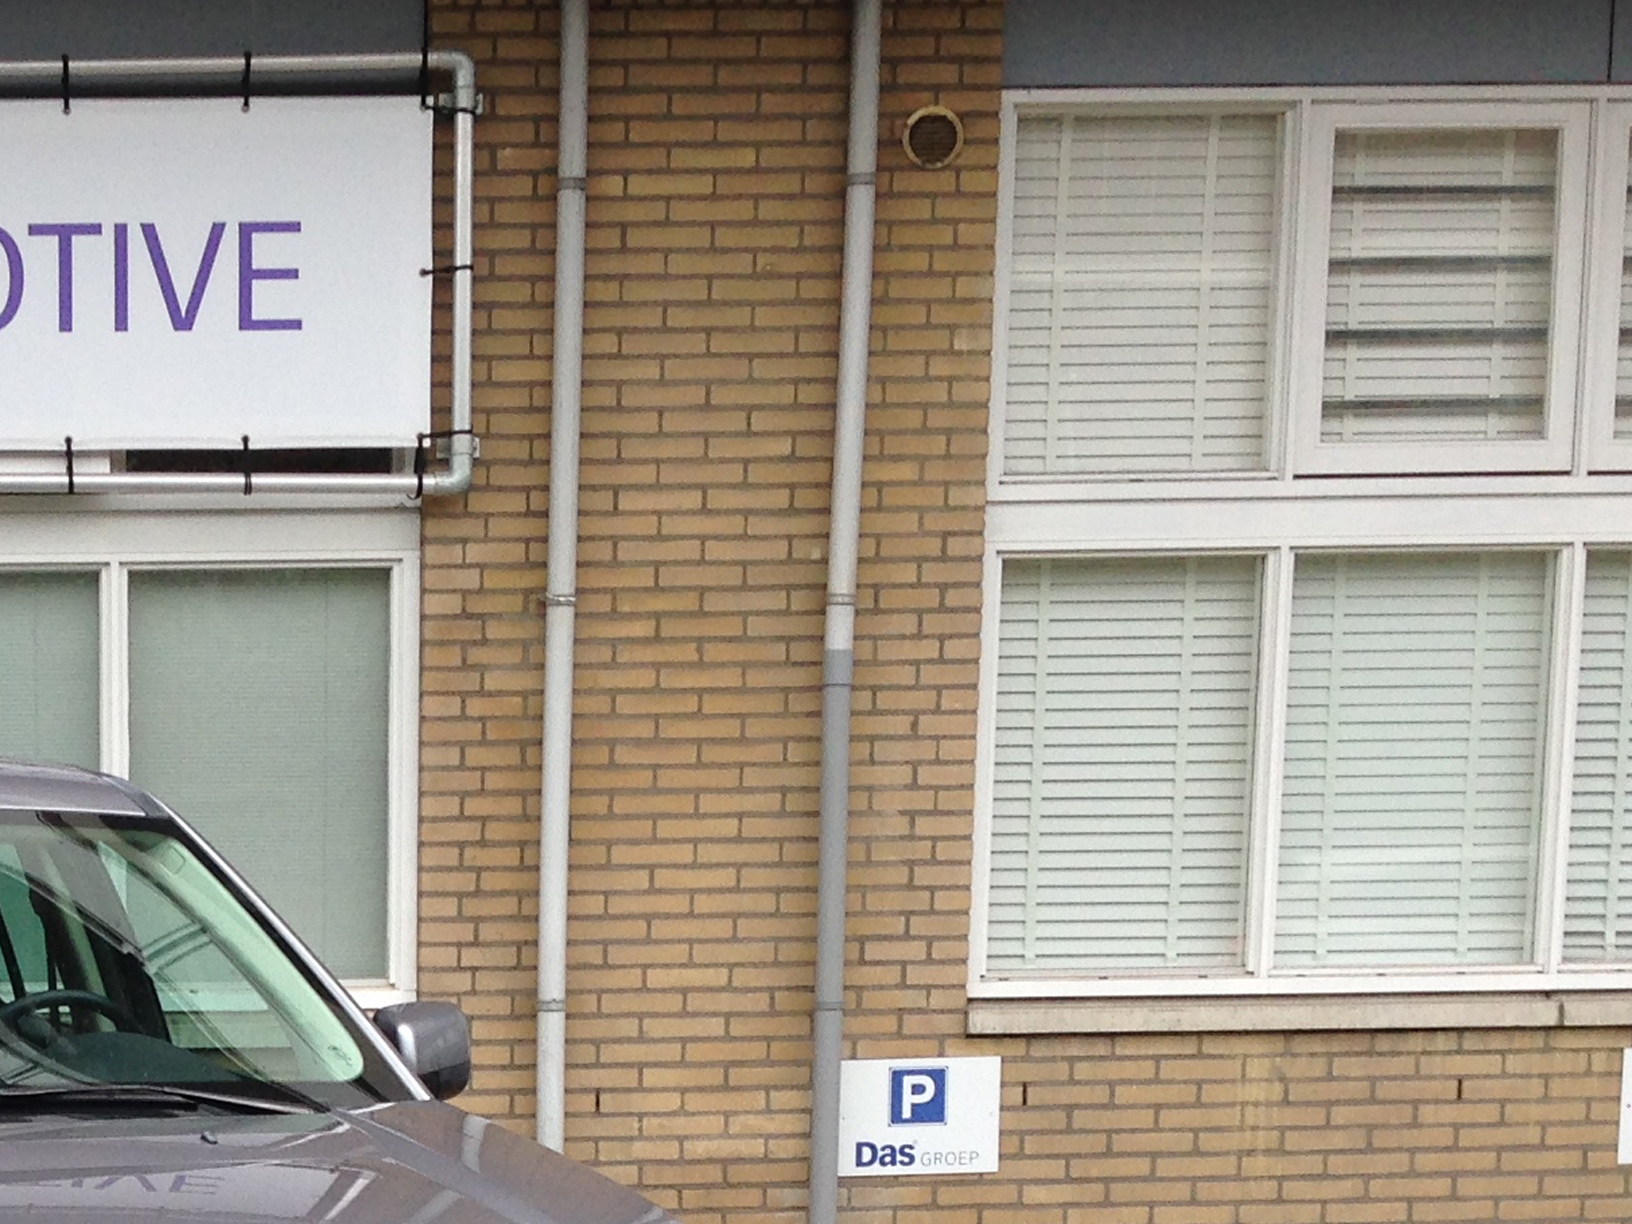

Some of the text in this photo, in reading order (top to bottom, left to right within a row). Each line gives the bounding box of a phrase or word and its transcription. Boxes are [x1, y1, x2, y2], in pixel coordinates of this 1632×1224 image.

[901, 1074, 936, 1120] P
[854, 1141, 980, 1168] Das GROEP
